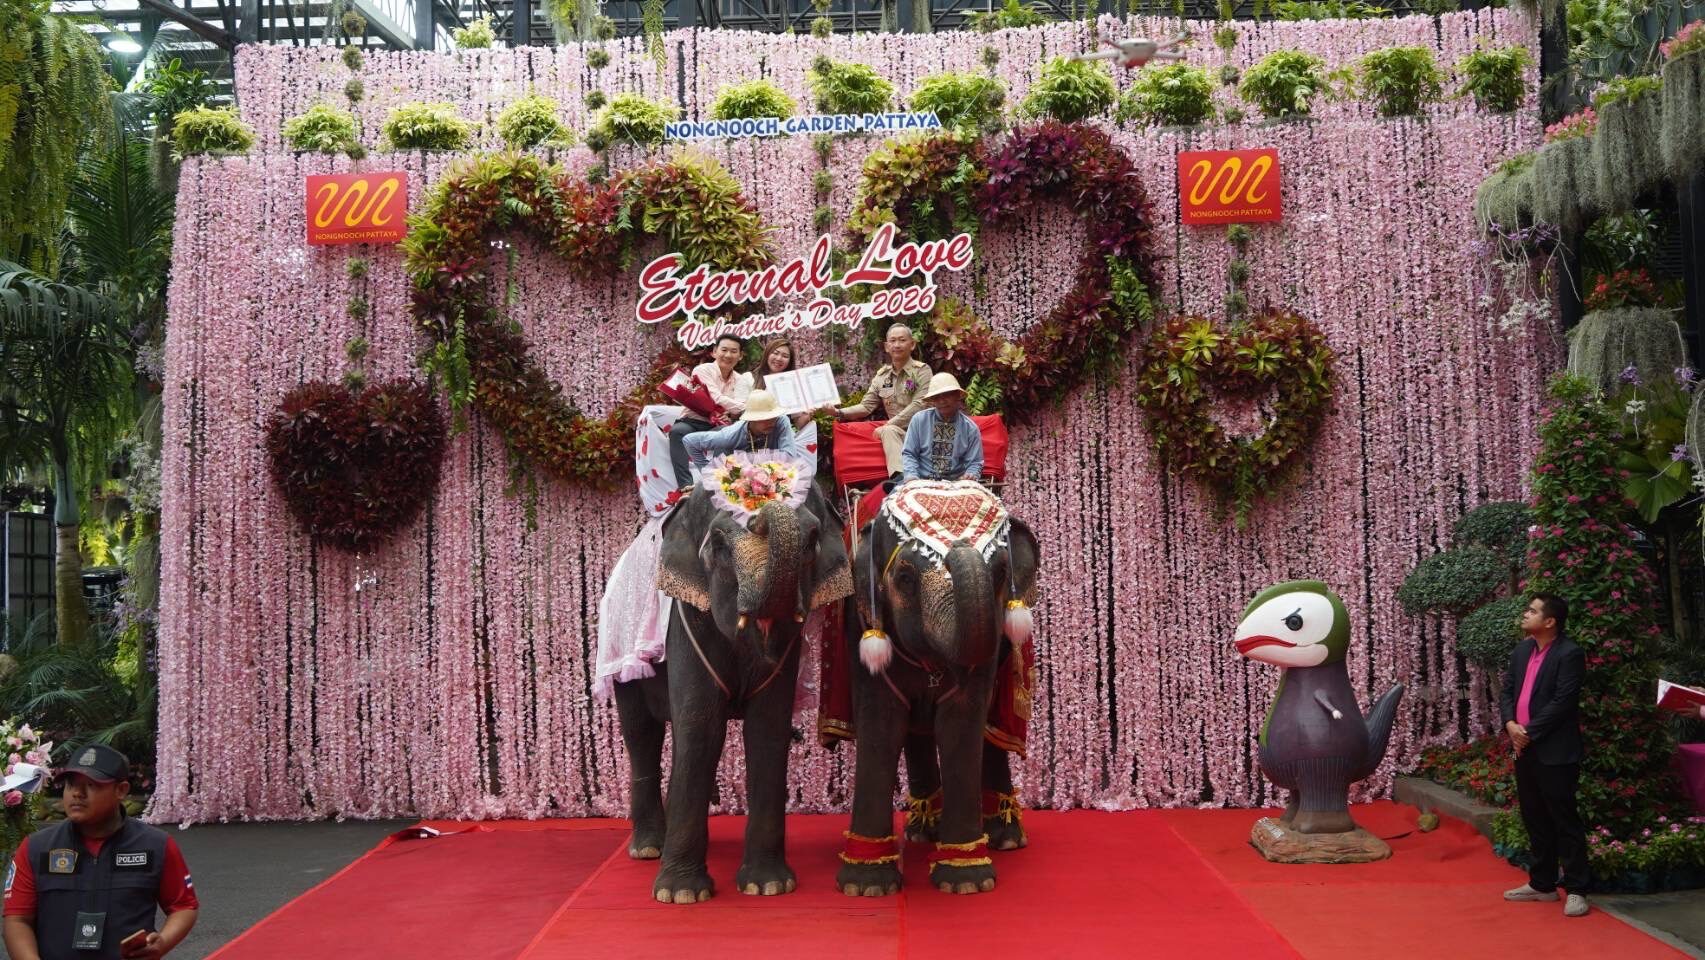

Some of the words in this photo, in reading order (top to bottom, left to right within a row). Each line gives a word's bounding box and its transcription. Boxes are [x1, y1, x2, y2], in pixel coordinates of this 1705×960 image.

[666, 118, 778, 139] NONGNOOCH
[786, 115, 855, 133] GARDEN
[864, 112, 940, 130] PATTAYA
[1190, 209, 1240, 218] NONGNOOCH
[1240, 208, 1273, 216] PATTAYA
[315, 232, 365, 241] NONGNOOCH
[366, 231, 398, 239] PATTAYA
[638, 237, 831, 321] Eternal
[844, 225, 971, 286] Love
[809, 301, 862, 327] Day
[872, 287, 934, 316] 2026
[118, 855, 145, 863] POLICE
